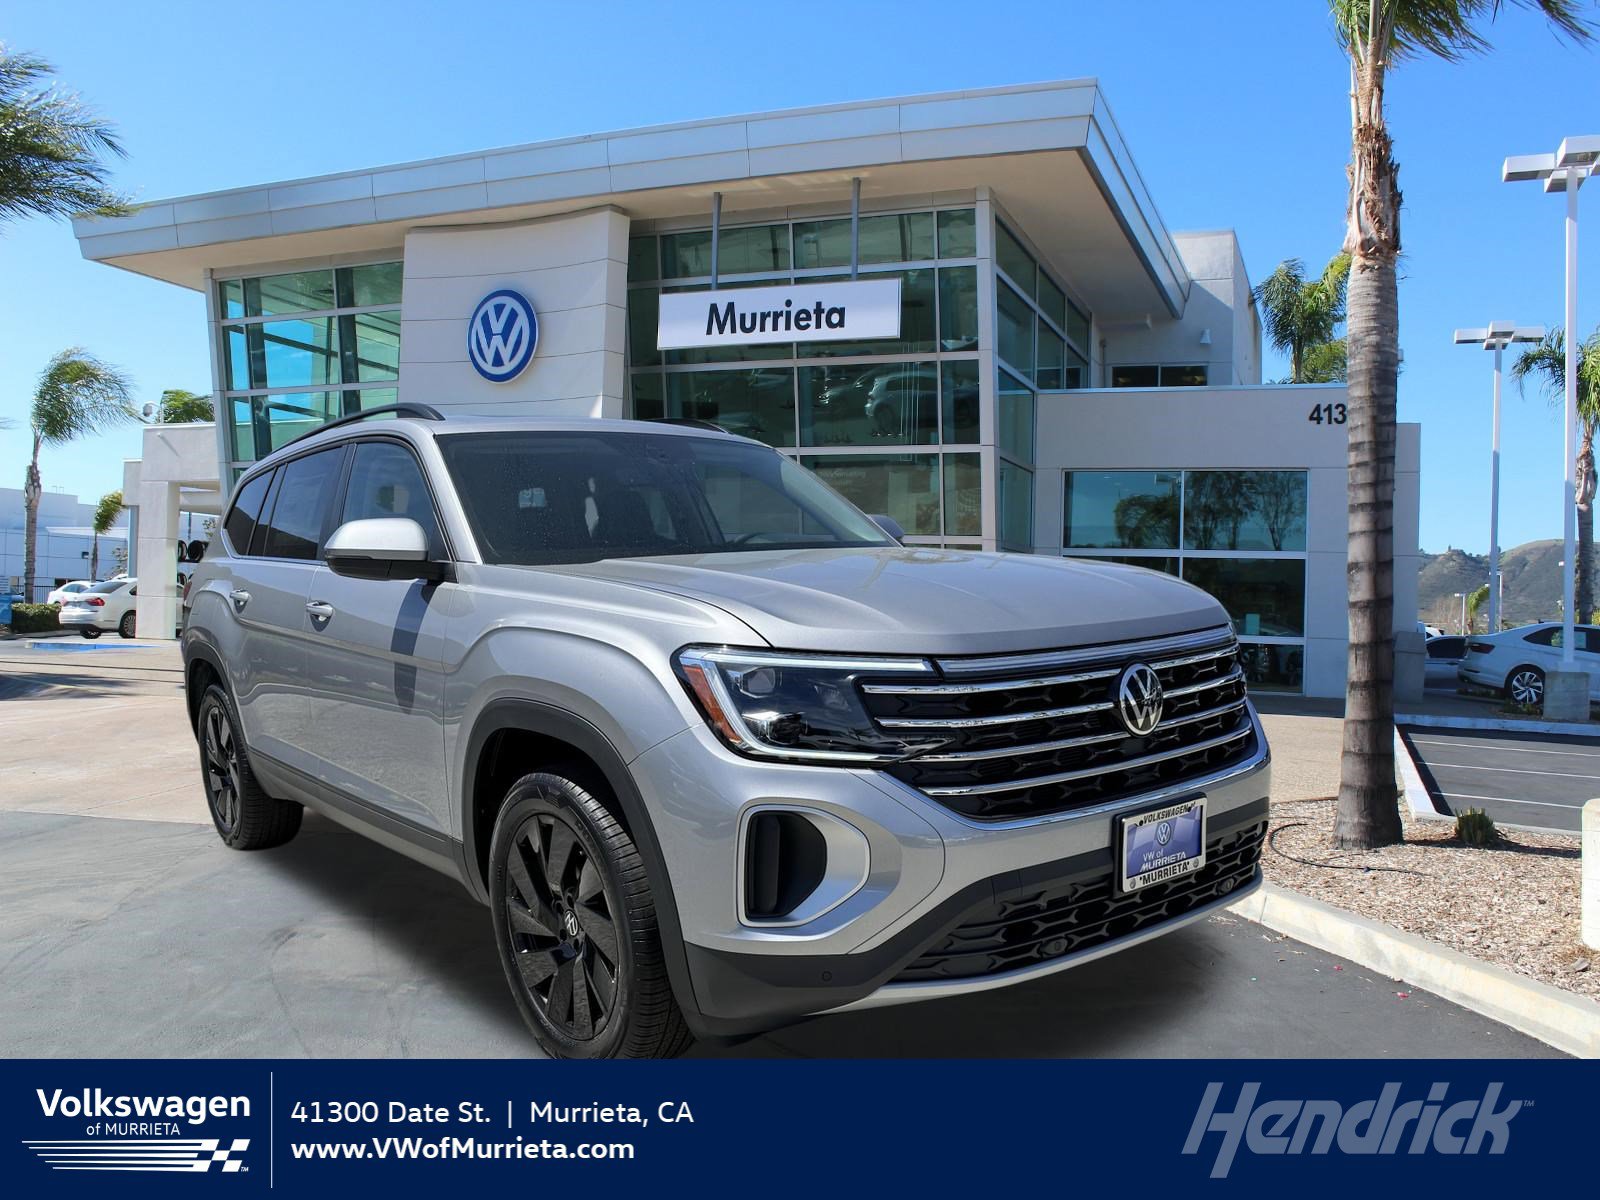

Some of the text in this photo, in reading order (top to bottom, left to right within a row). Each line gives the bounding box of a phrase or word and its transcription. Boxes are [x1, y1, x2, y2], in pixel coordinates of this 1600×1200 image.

[705, 299, 846, 336] Murrieta
[1308, 403, 1347, 425] 413
[1143, 805, 1188, 824] VOLKSWAGEN
[1140, 851, 1187, 873] MURRIETA
[1143, 850, 1155, 862] VW
[1141, 863, 1189, 885] MURRIETA
